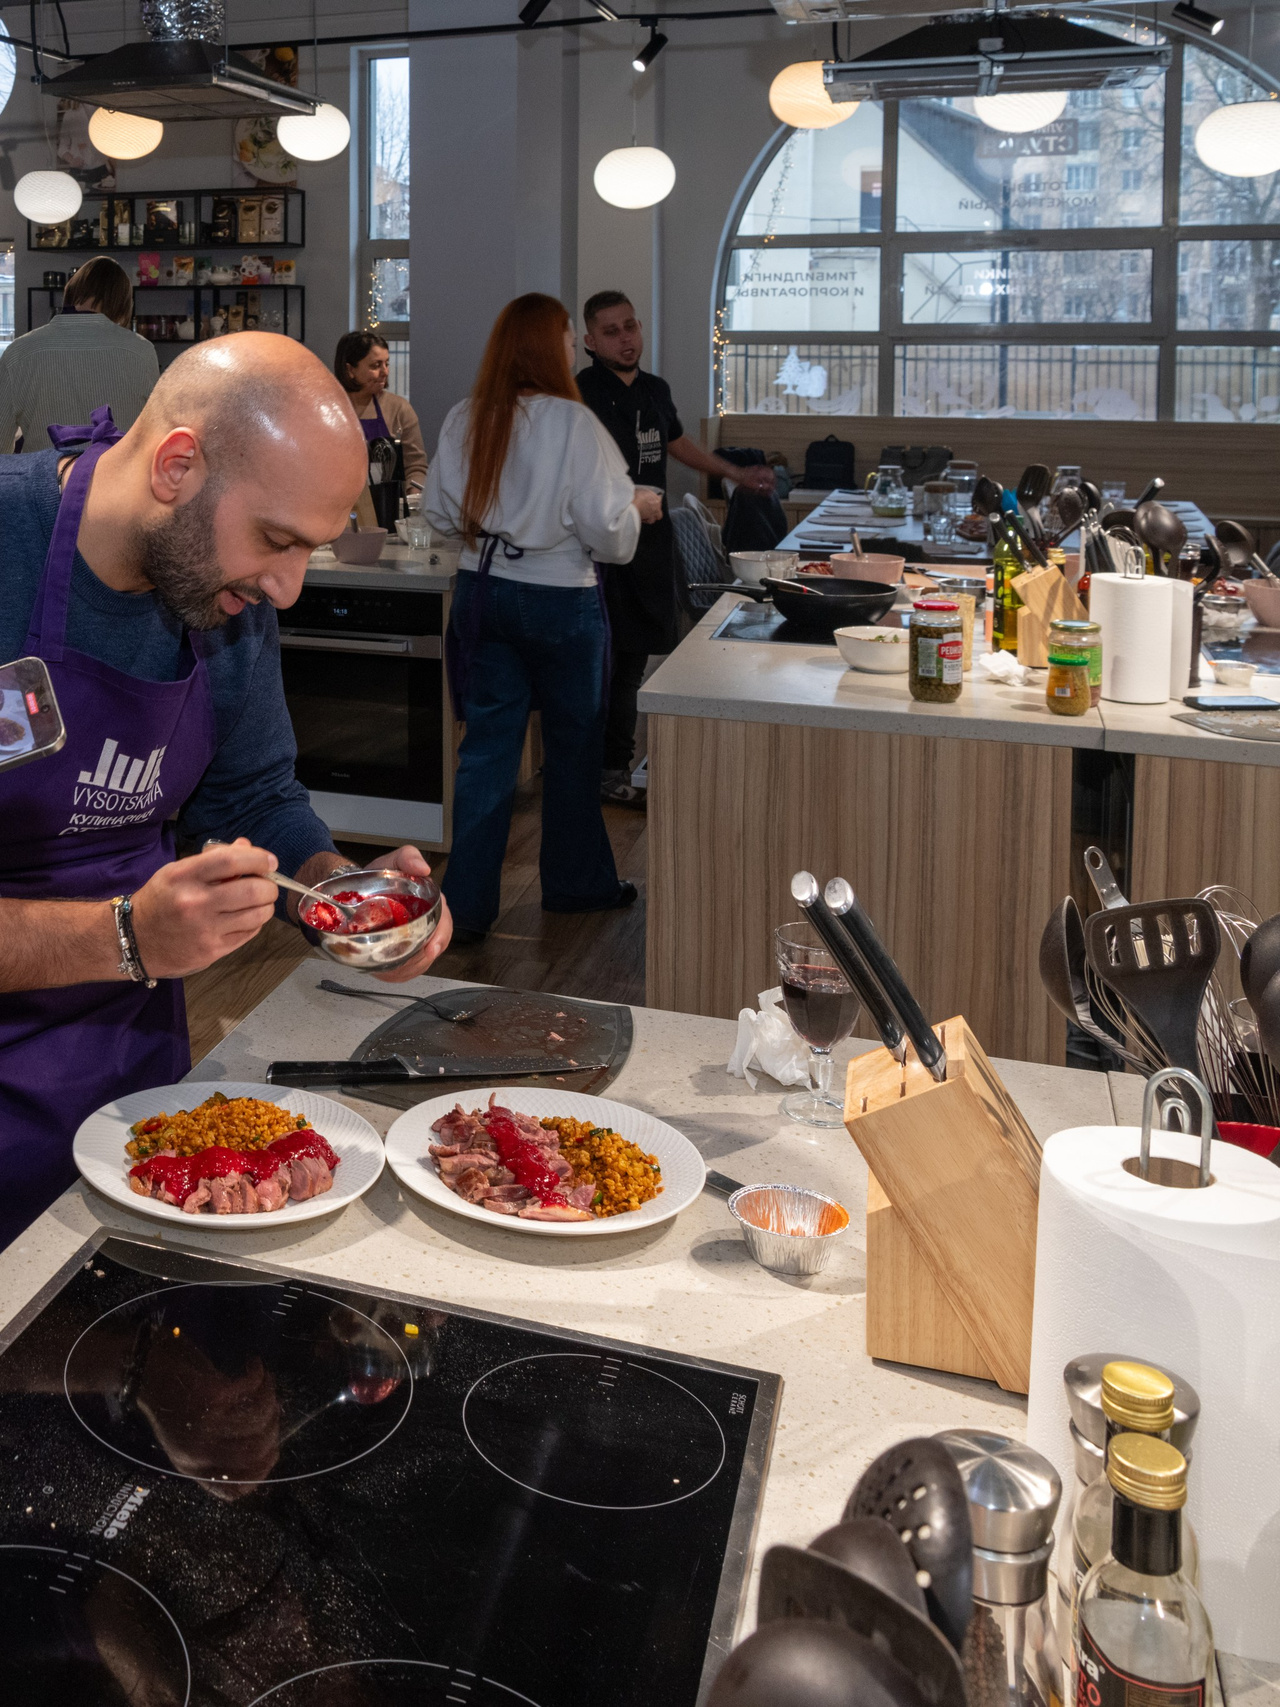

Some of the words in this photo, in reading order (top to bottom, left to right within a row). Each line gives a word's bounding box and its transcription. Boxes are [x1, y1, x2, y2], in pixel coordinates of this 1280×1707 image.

[77, 738, 167, 794] Juli
[90, 1482, 134, 1536] INDUCTION
[103, 1486, 150, 1539] Miele
